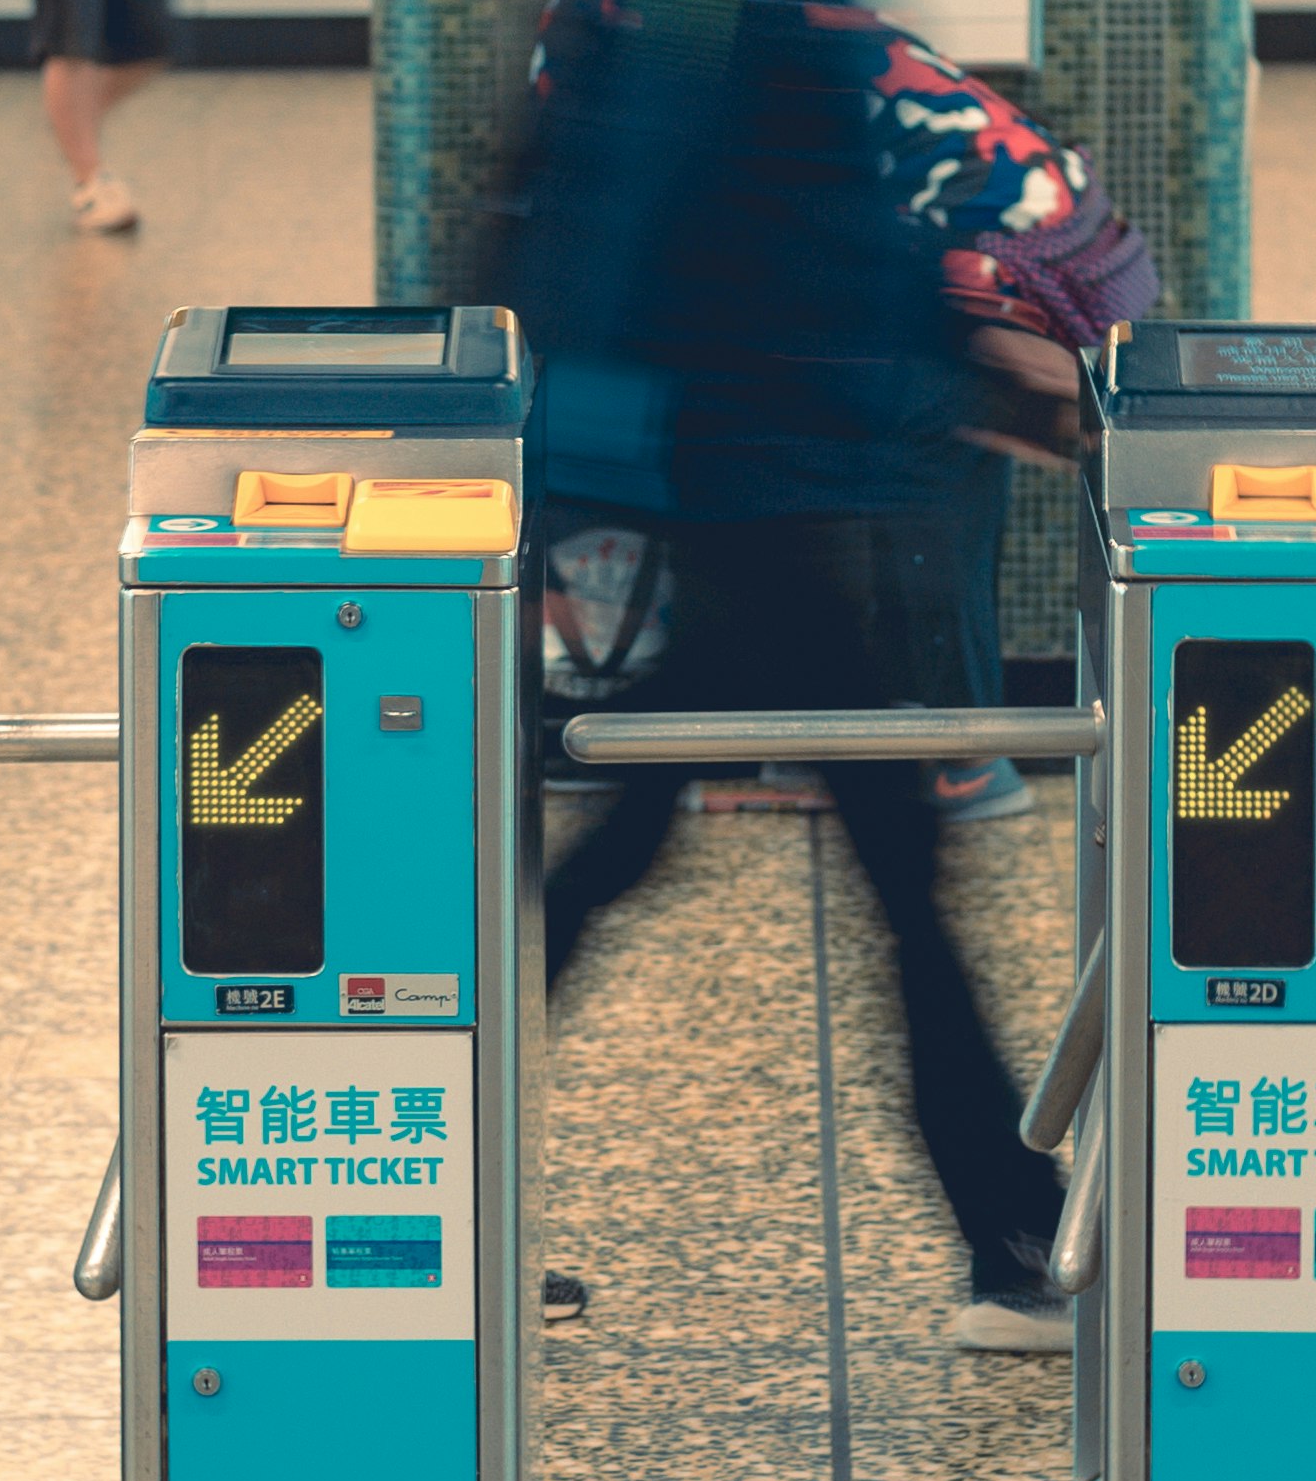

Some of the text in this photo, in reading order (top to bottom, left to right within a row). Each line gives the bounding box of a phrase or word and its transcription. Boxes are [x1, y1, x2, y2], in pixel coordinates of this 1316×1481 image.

[259, 990, 285, 1009] 2E
[395, 988, 451, 1008] Camp
[1249, 983, 1278, 1003] 2D
[348, 998, 385, 1011] Alcatel
[195, 1085, 448, 1145] 智能車票
[197, 1157, 444, 1187] SMART TICKET
[1187, 1148, 1308, 1178] SMART
